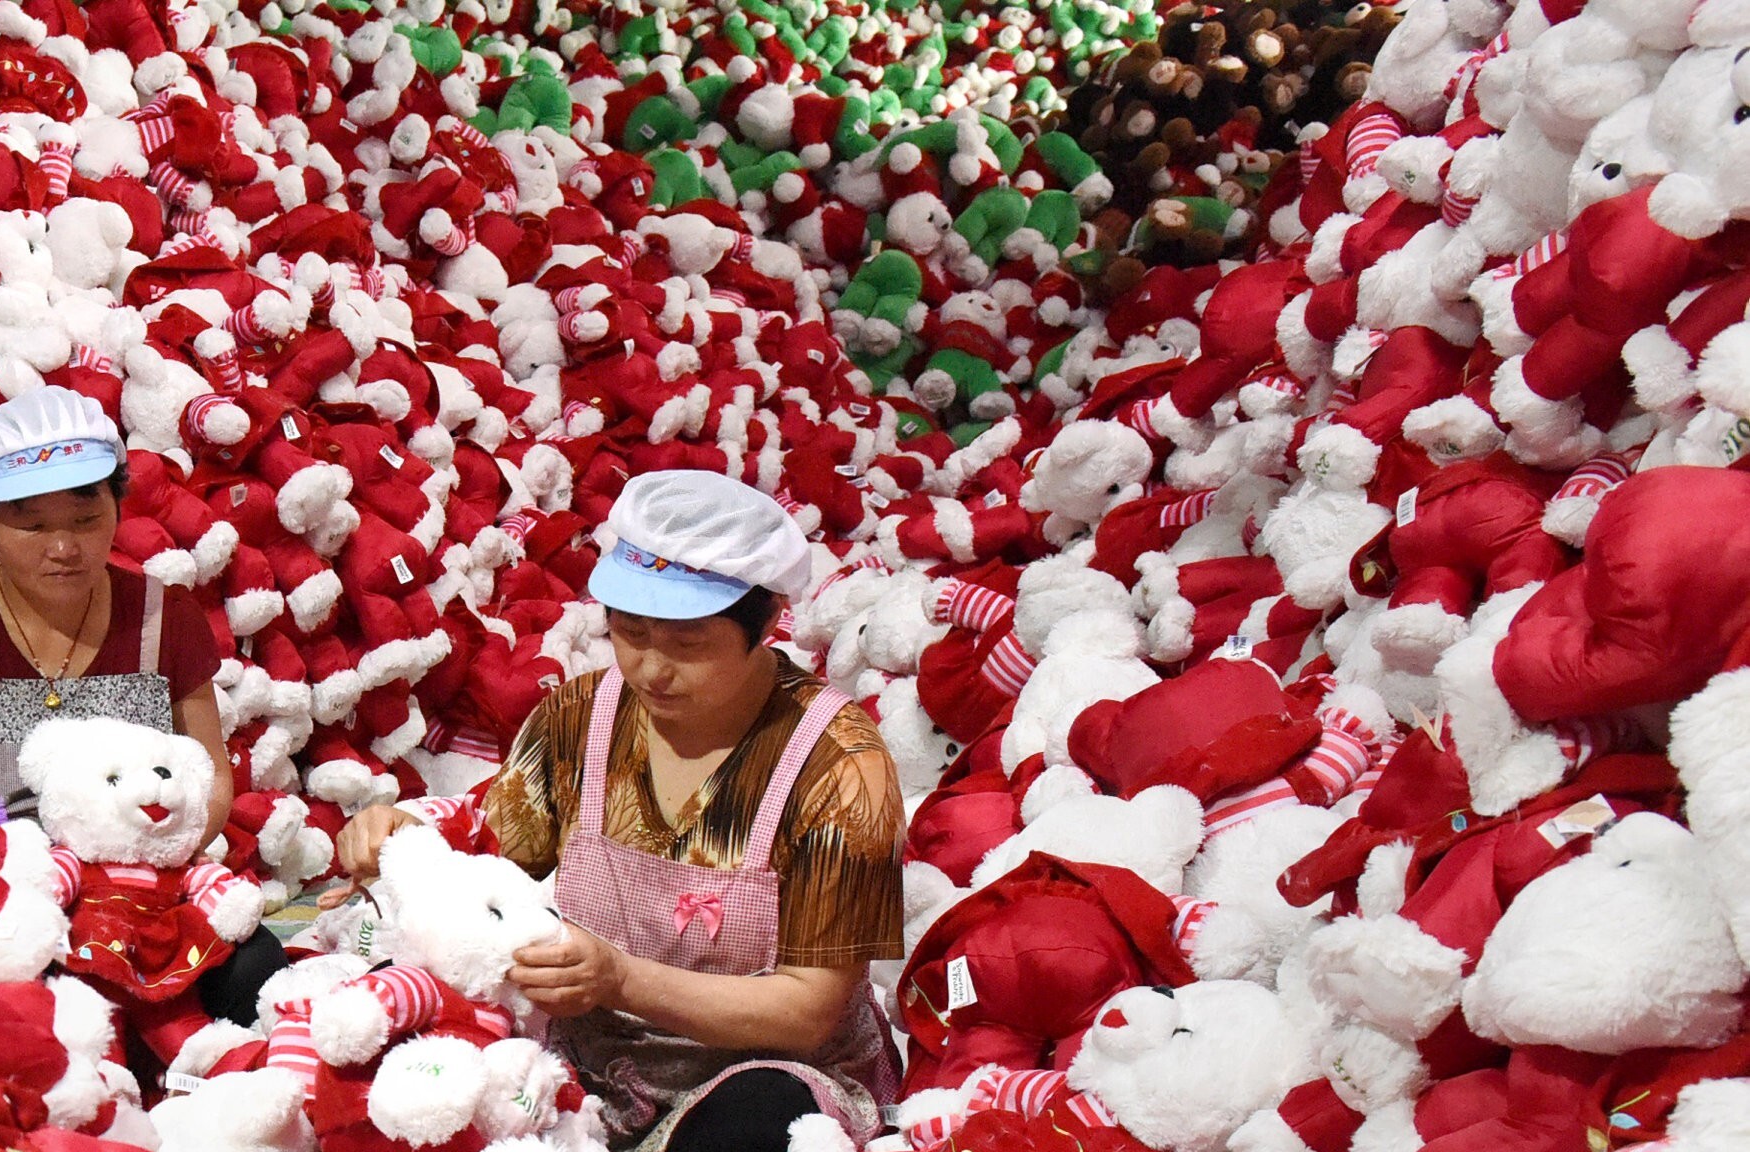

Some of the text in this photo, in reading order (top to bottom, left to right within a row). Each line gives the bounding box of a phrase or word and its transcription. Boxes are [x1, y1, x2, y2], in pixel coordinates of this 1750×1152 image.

[7, 443, 83, 469] 三和 集团
[358, 920, 374, 957] 2018
